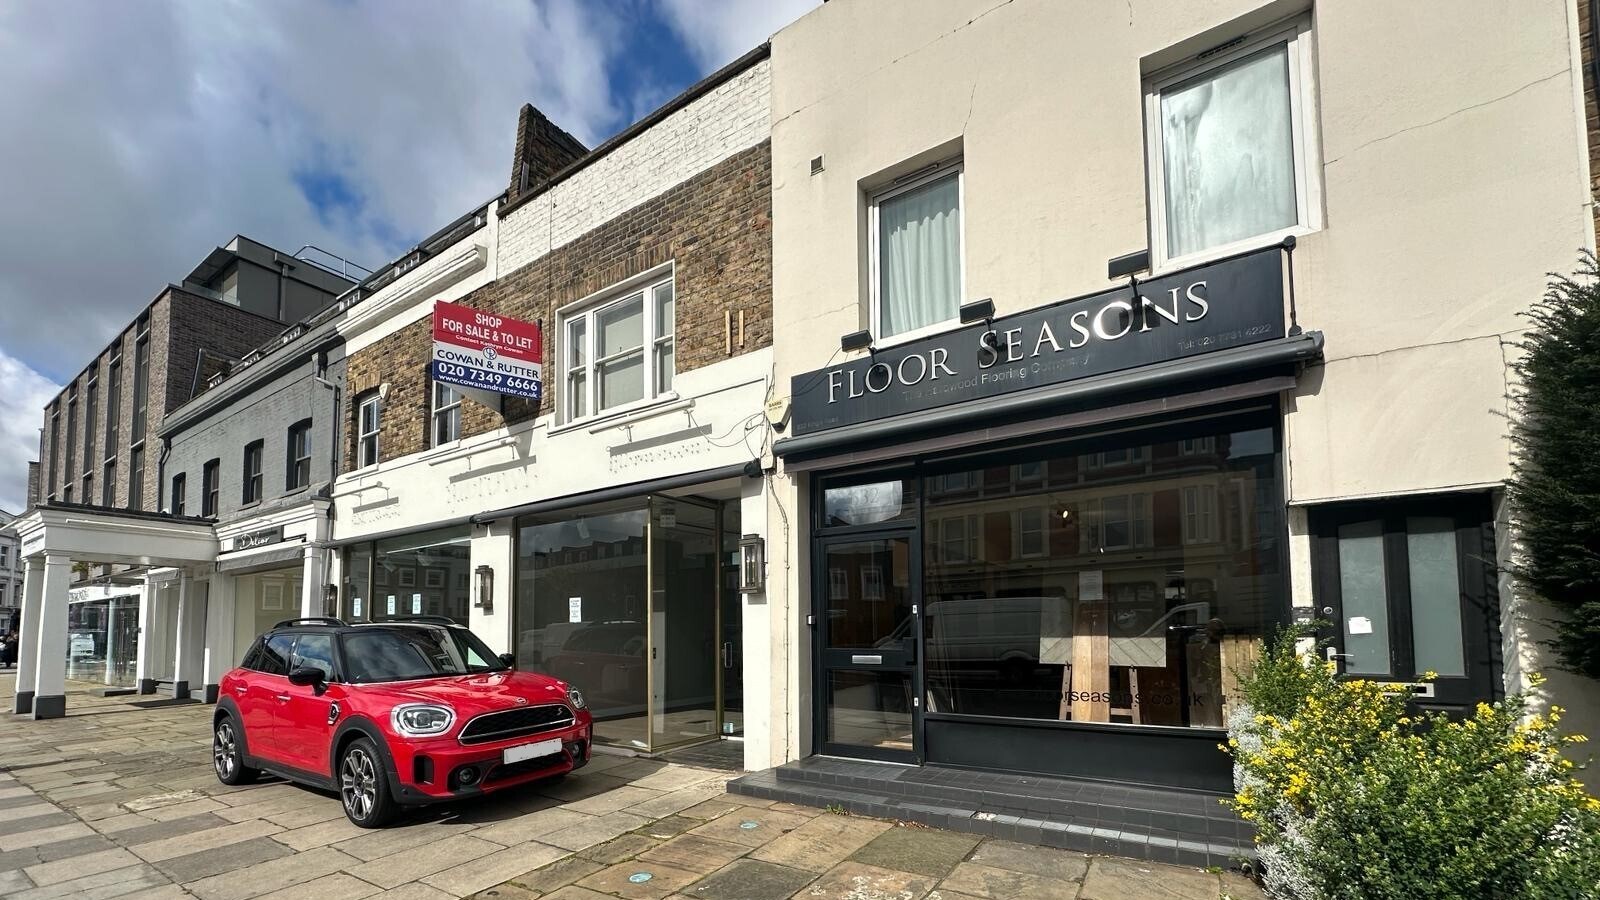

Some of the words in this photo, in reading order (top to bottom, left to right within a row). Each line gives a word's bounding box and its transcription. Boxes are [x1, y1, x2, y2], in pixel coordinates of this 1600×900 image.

[442, 318, 463, 333] FOR
[466, 325, 490, 340] SALE
[492, 331, 499, 342] &
[501, 332, 514, 345] TO
[516, 336, 533, 349] LET
[475, 313, 502, 328] SHOP
[455, 334, 480, 345] Contact
[503, 346, 524, 354] Cowan
[827, 348, 958, 404] FLOOR
[978, 281, 1210, 369] SEASONS
[437, 350, 484, 368] COWAN
[486, 361, 494, 370] &
[497, 362, 539, 379] RUTTER
[438, 362, 465, 377] 020
[469, 369, 502, 385] 7349
[506, 377, 538, 392] 6666
[438, 374, 538, 398] www.cowanandrutter.co.uk
[924, 376, 978, 396] dwood
[981, 366, 1028, 385] Flooring
